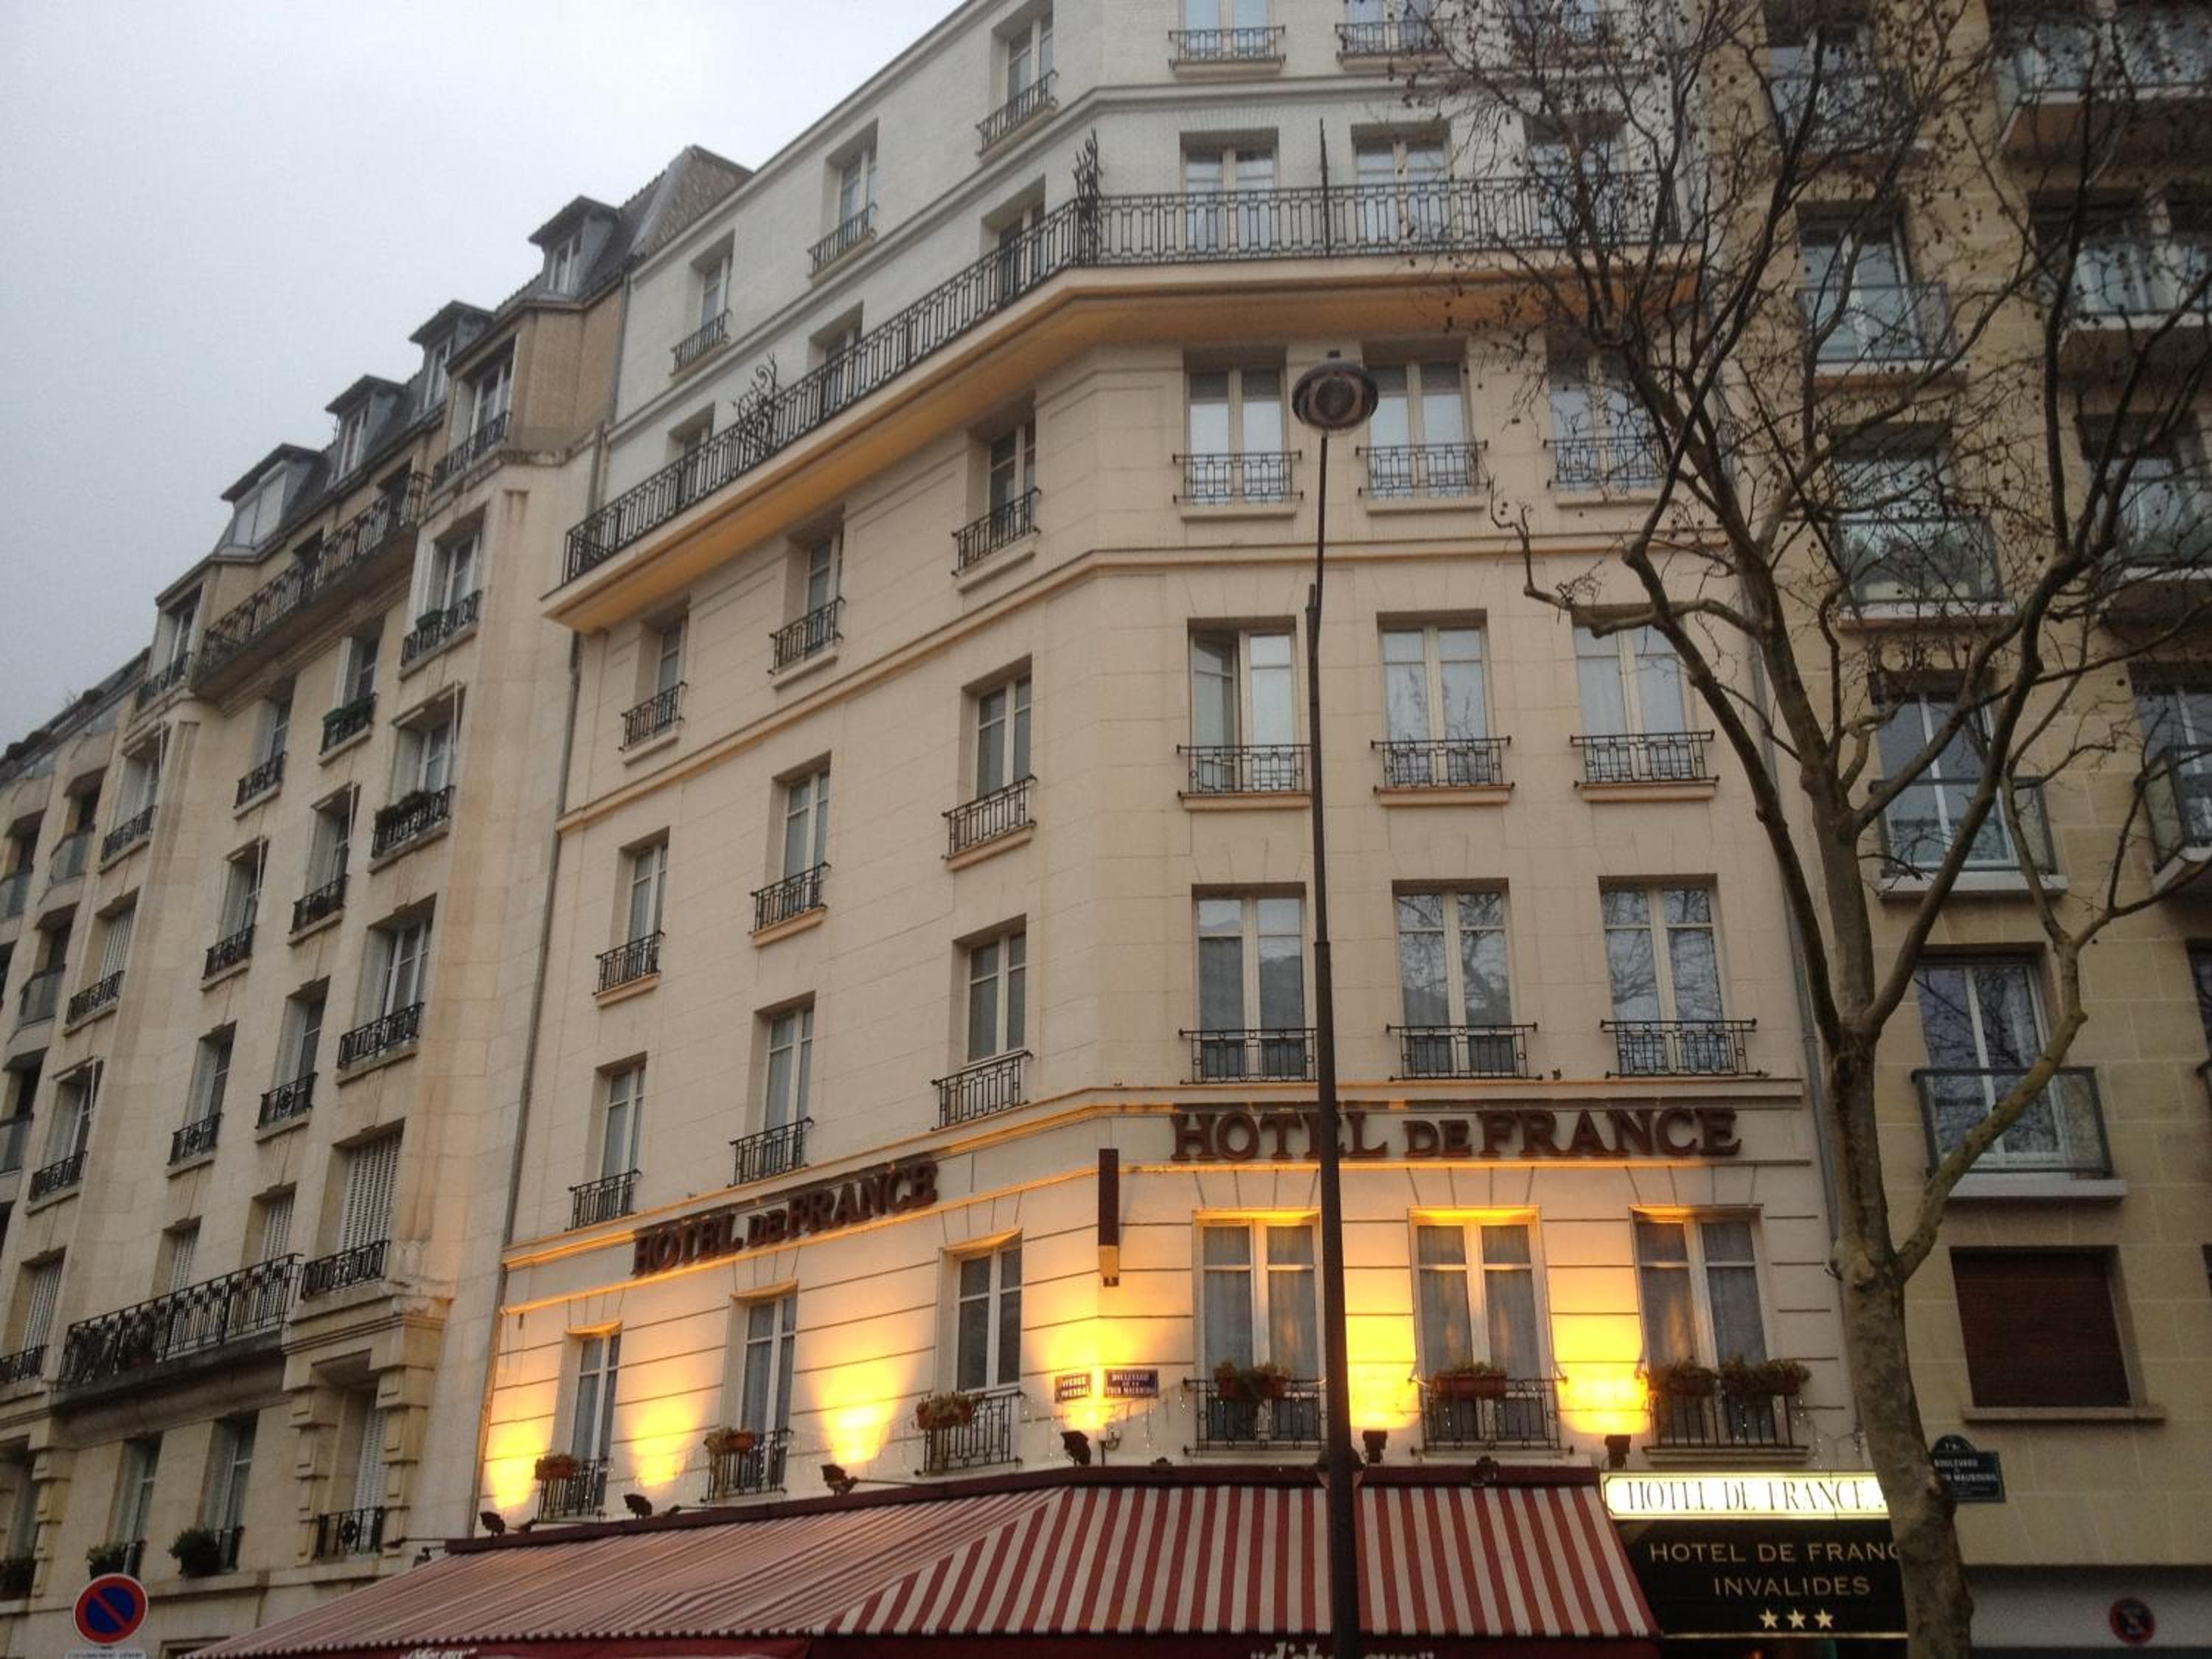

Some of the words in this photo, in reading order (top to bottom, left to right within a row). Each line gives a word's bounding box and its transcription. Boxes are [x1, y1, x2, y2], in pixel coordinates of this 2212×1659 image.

[1170, 1110, 1388, 1162] HOTEL
[1402, 1119, 1472, 1158] DE
[1476, 1107, 1742, 1158] FRANCE
[631, 1213, 744, 1277] HOTEL
[787, 1161, 940, 1238] FRANCE
[1627, 1481, 1713, 1510] HOTEL
[1724, 1481, 1756, 1511] DE
[1767, 1481, 1869, 1510] FRANCE
[1650, 1543, 1747, 1563] HOTEL
[1759, 1543, 1795, 1563] DE
[1714, 1576, 1871, 1597] INVALIDES
